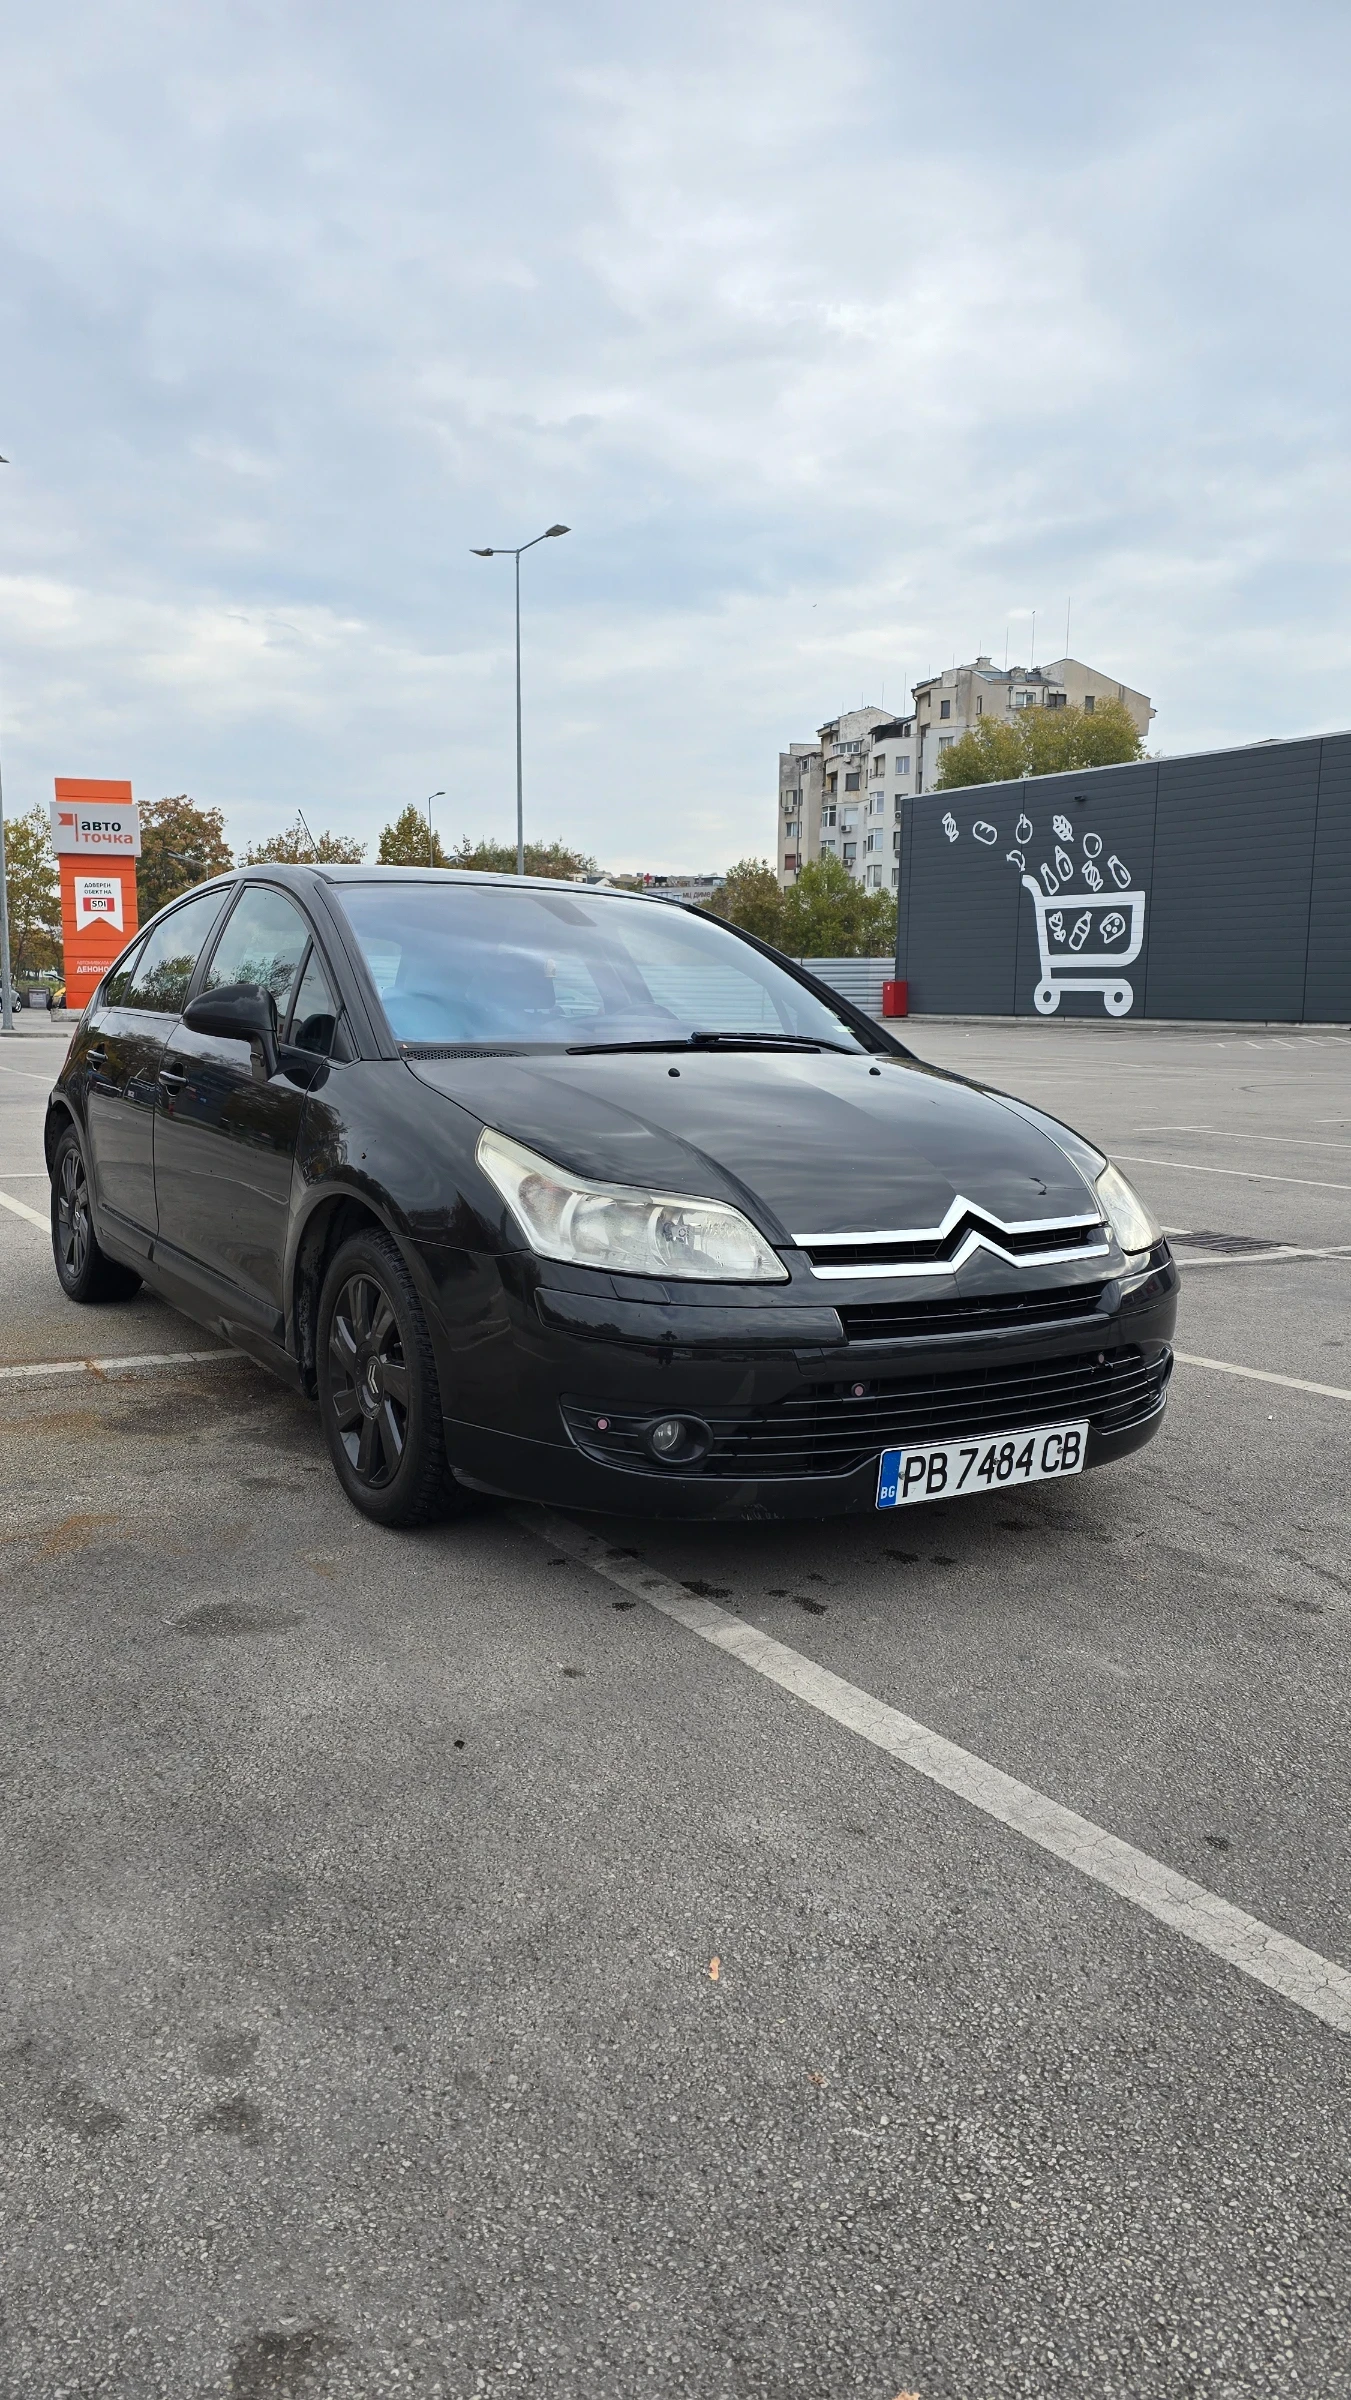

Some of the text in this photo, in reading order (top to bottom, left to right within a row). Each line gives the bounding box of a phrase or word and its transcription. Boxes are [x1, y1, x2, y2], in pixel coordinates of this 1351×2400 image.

[81, 821, 121, 831] авто
[82, 833, 133, 844] точка
[92, 900, 106, 908] SDI
[902, 1431, 1081, 1498] PB 7484 CB
[880, 1486, 896, 1500] BG
